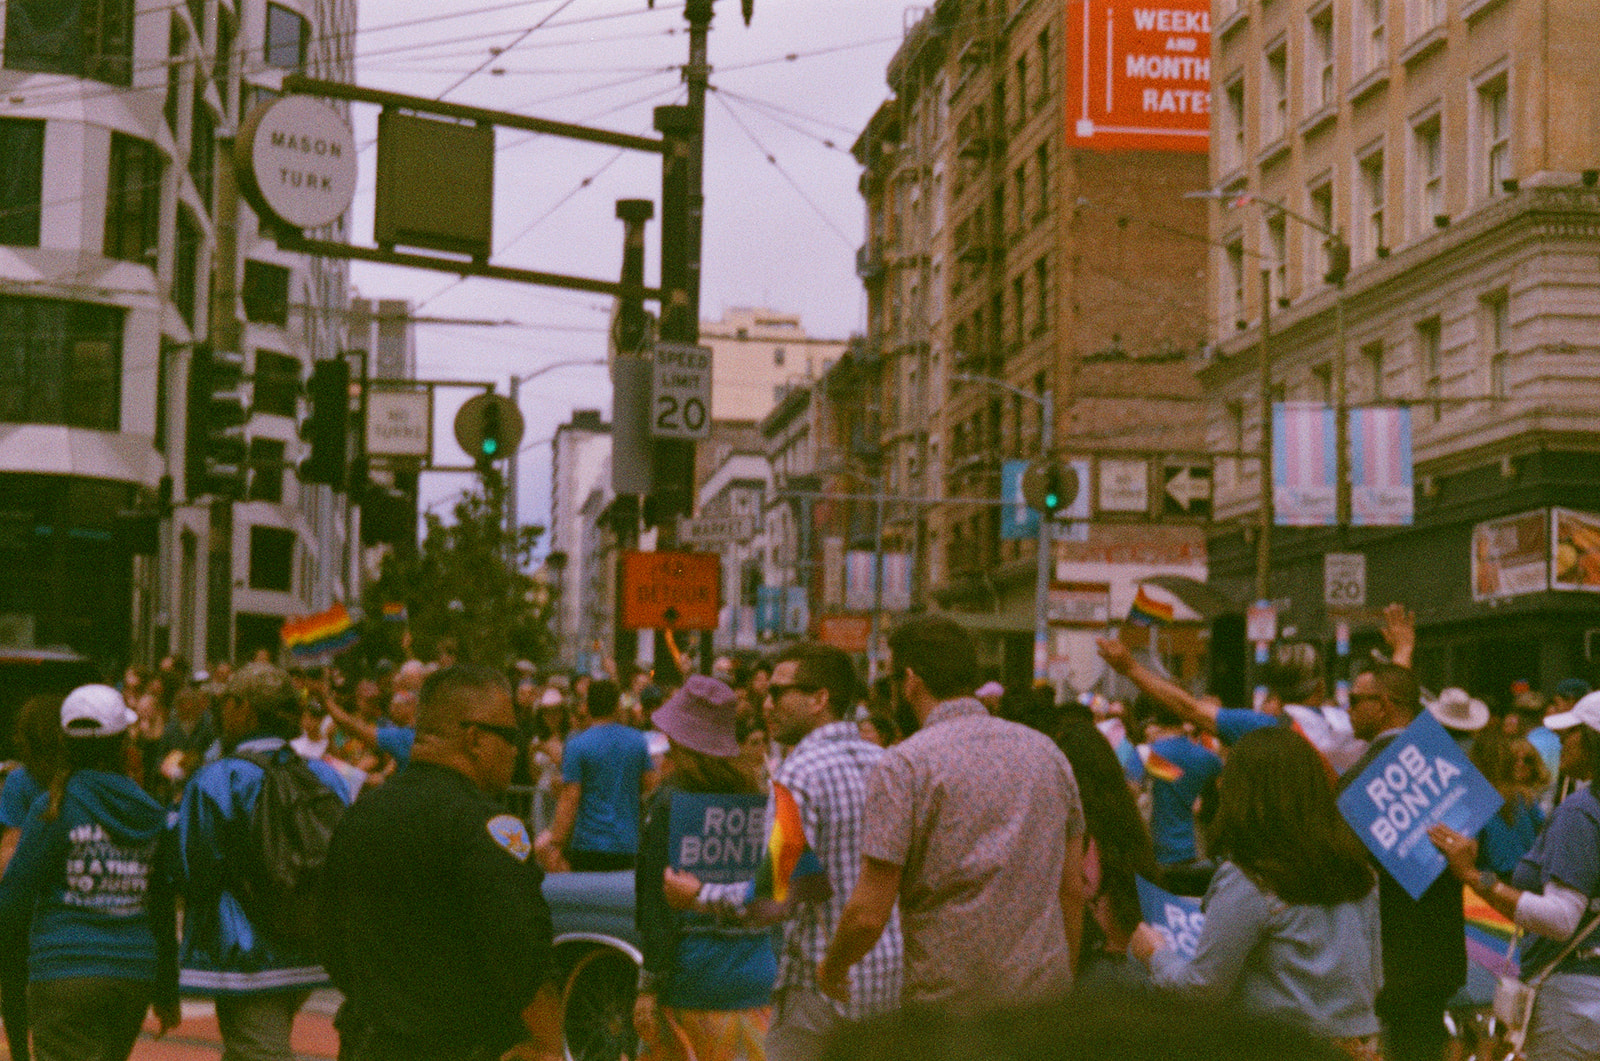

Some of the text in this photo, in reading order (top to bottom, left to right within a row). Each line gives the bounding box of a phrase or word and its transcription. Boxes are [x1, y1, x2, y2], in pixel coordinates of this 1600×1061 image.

[1133, 9, 1211, 33] WEEKL
[1166, 37, 1197, 52] AND
[1126, 55, 1211, 80] MONTH
[270, 131, 342, 158] MASON
[280, 167, 332, 192] TURK
[657, 350, 709, 369] SPEED
[661, 373, 701, 389] LIMIT
[656, 395, 706, 431] 20
[1330, 580, 1361, 600] 20
[1366, 744, 1427, 812] ROB
[1370, 756, 1461, 850] BONTA
